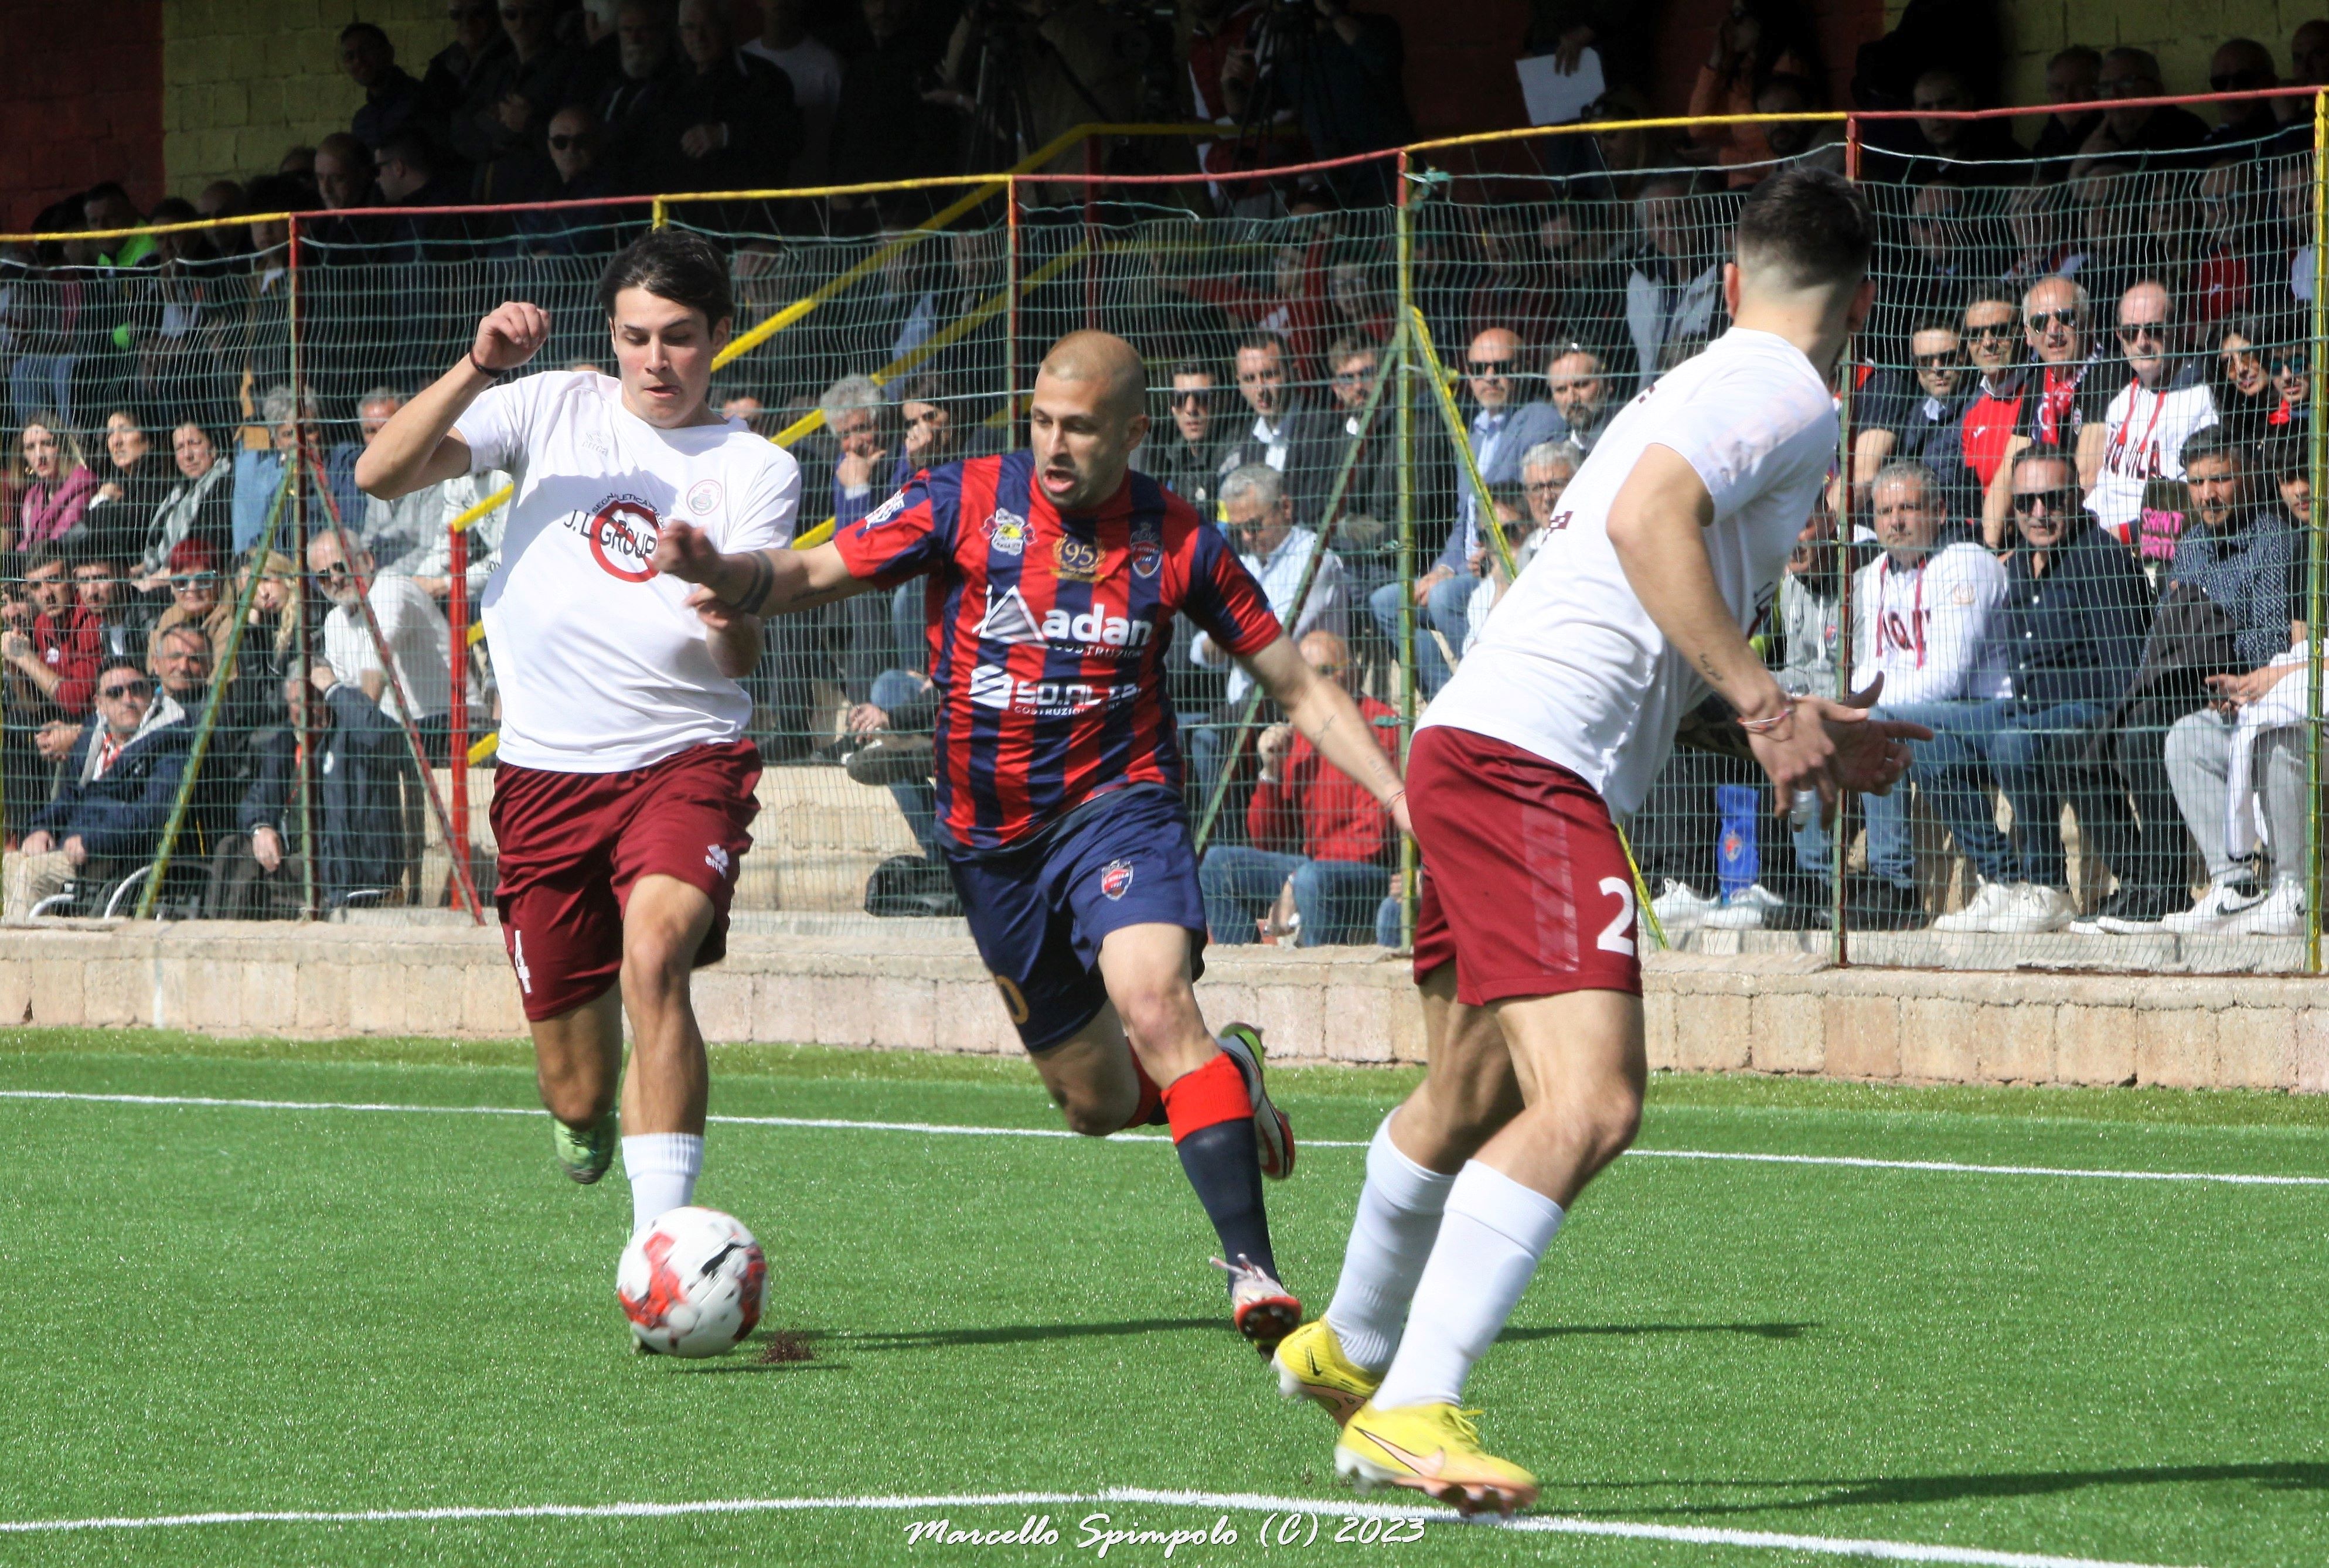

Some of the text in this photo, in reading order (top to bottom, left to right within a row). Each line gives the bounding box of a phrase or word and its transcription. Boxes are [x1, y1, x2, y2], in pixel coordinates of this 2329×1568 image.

[600, 520, 658, 559] GROUP
[1065, 543, 1095, 566] 95
[1041, 603, 1153, 646] adan
[1597, 876, 1635, 957] 2
